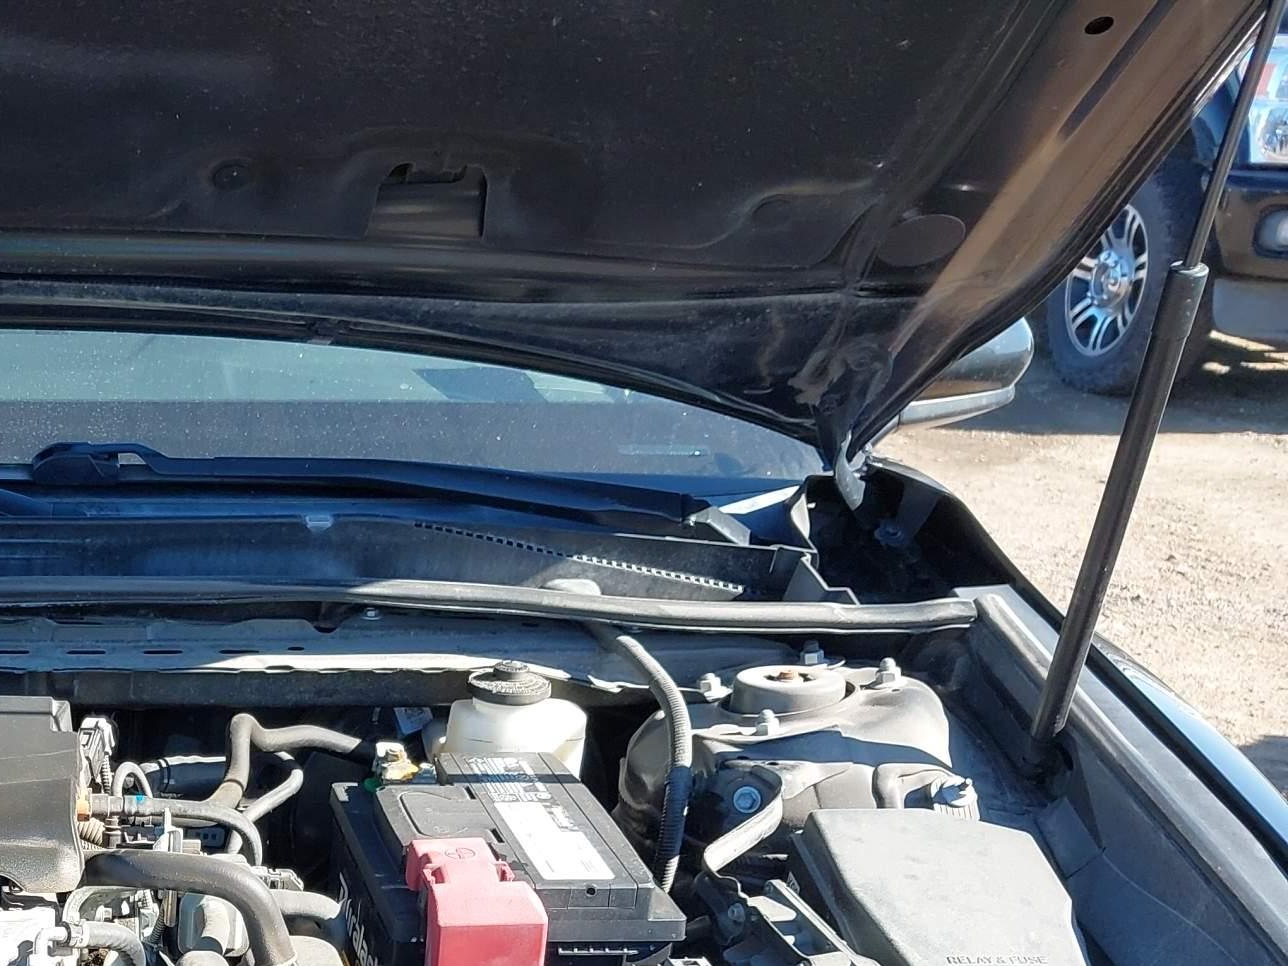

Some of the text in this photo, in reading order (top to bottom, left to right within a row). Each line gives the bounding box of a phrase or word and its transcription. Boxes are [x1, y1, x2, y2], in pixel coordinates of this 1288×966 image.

[946, 955, 1048, 965] RELAY & FUSE
